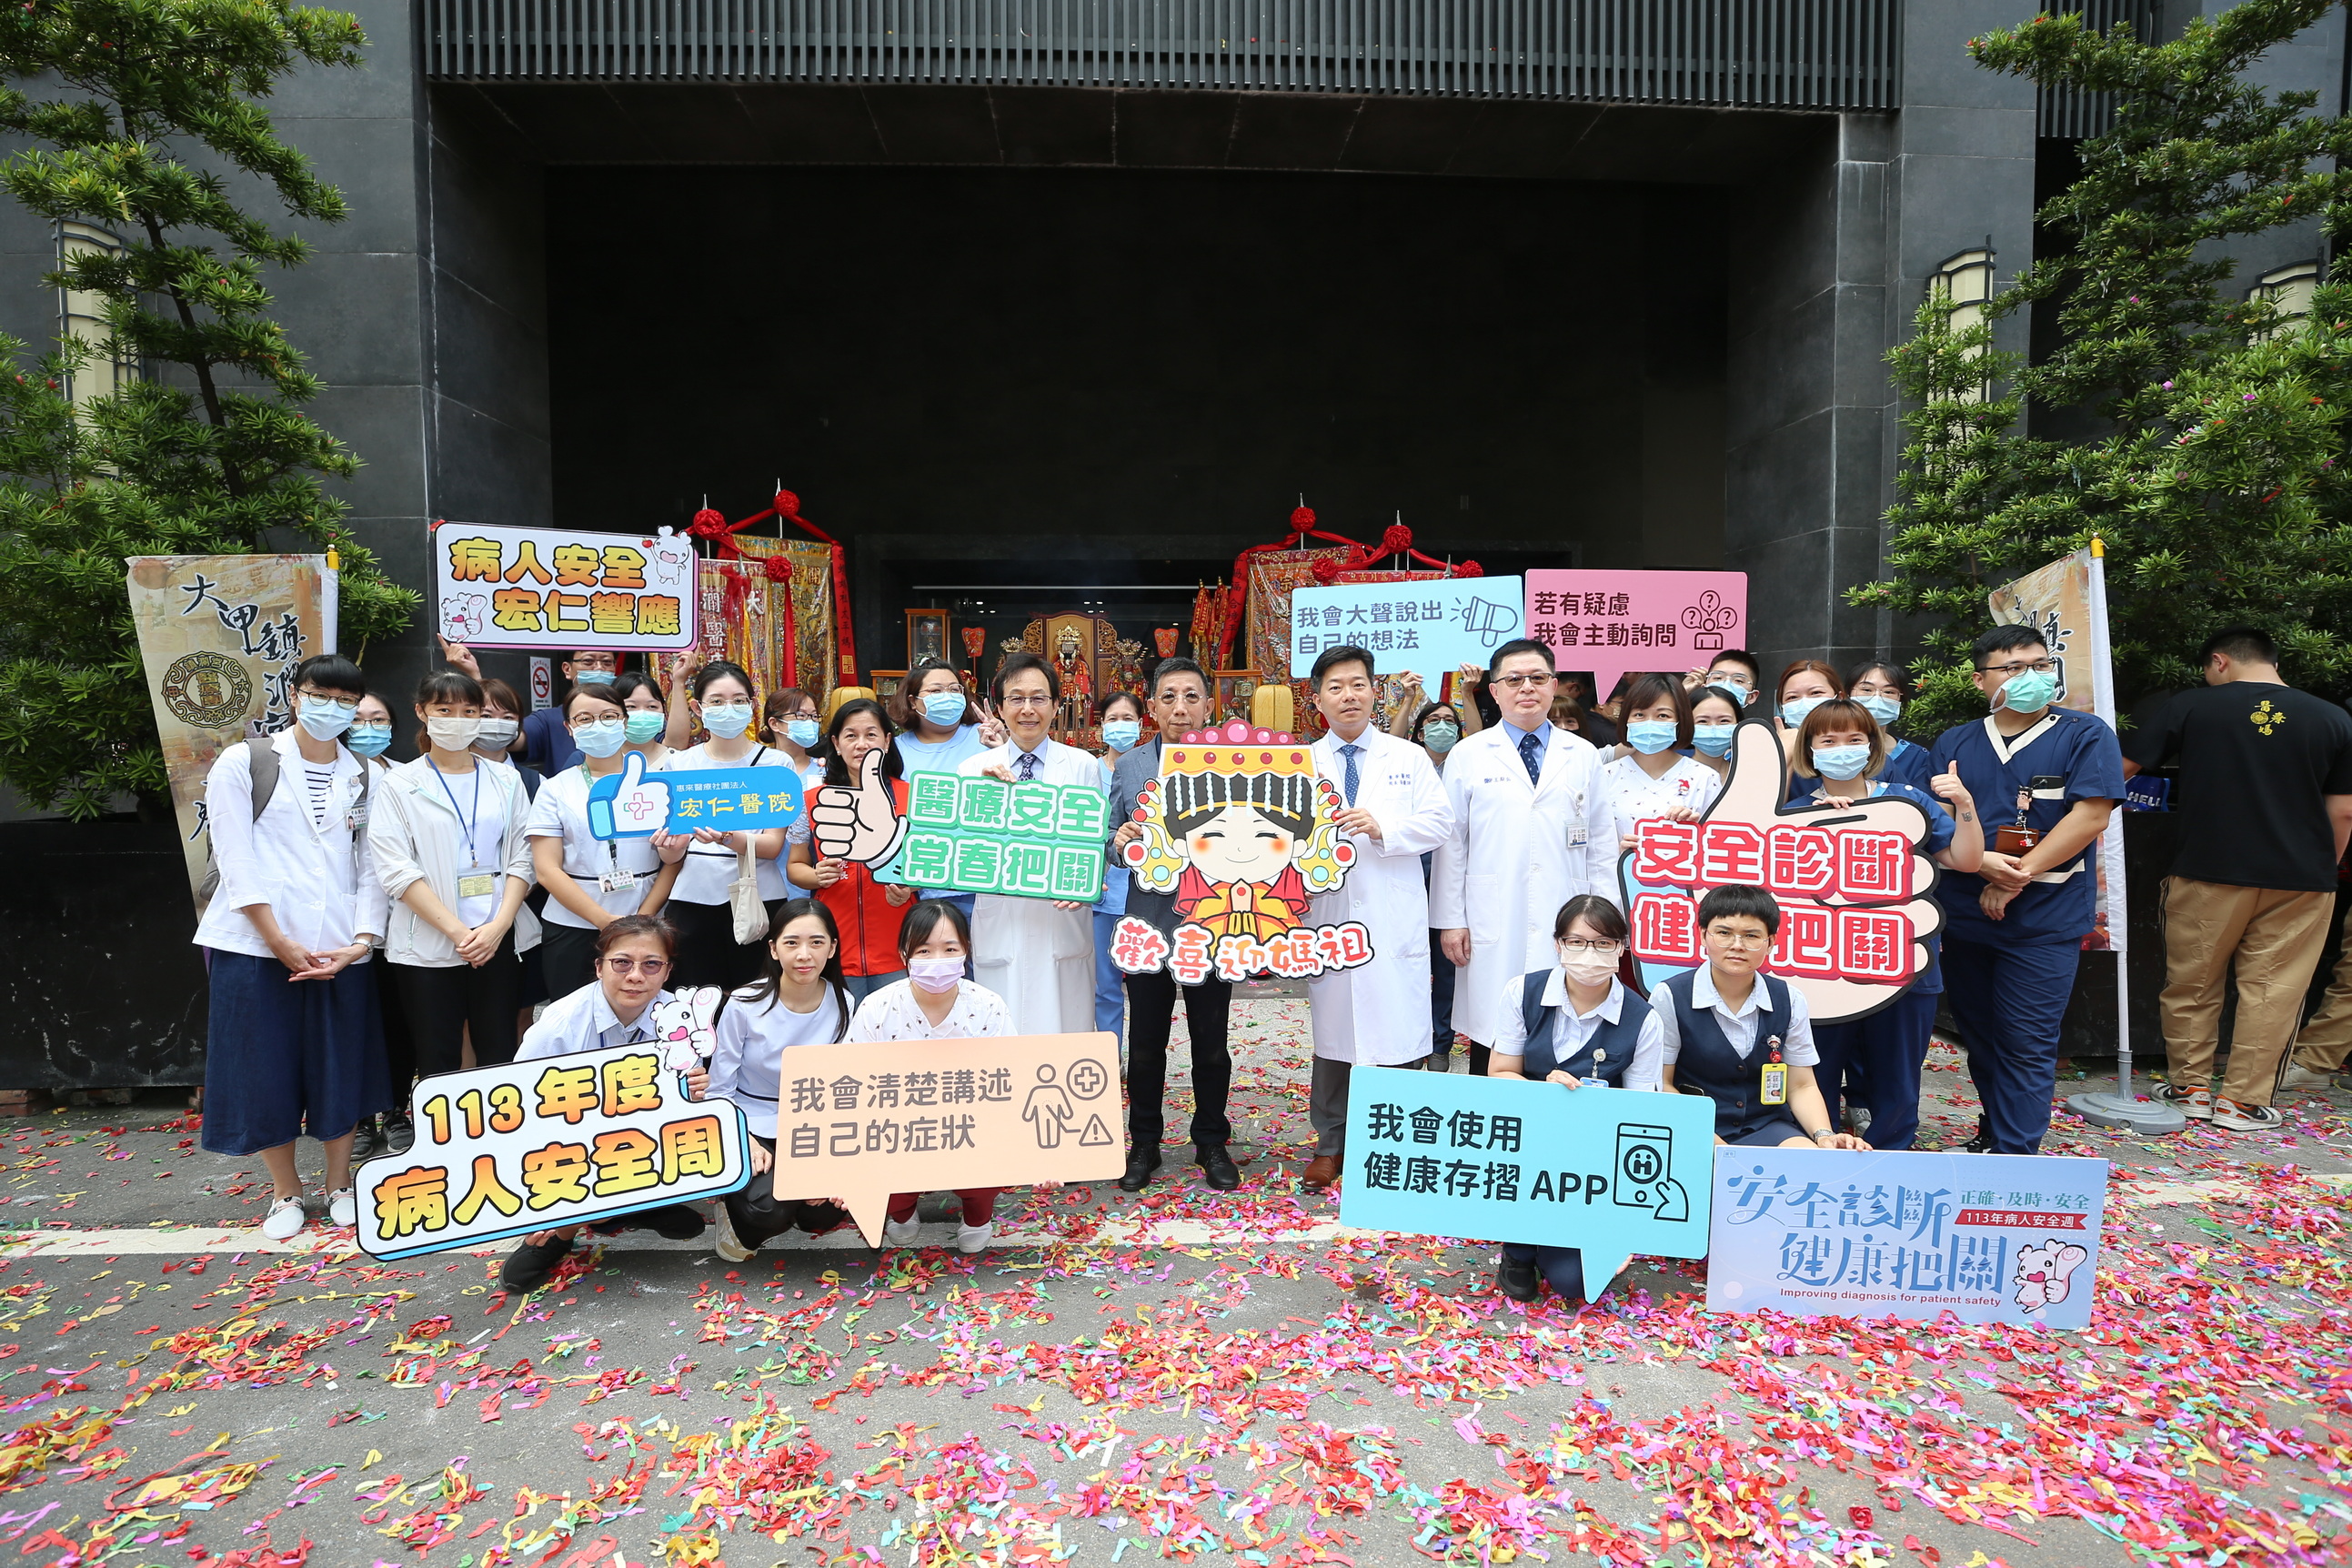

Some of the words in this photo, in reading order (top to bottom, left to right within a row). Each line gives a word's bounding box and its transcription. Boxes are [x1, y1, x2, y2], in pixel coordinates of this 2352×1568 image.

[449, 537, 647, 588] 病人安全
[492, 587, 680, 635] 宏仁響應
[1297, 599, 1443, 628] 我會大聲說出
[1534, 591, 1630, 616] 若有疑慮
[1533, 621, 1676, 647] 我會主動詢問
[676, 781, 748, 792] 惠來醫療社團法人
[677, 791, 796, 818] 宏仁醫院
[910, 773, 1106, 839] 醫療安全
[904, 834, 1101, 897] 常春把關
[1635, 819, 1905, 896] 安全診斷
[1114, 920, 1370, 980] 歡喜迎媽祖
[1633, 898, 1905, 979] 健把關
[789, 1067, 1013, 1114] 我會清楚講述
[789, 1114, 976, 1159] 自己的症狀
[1367, 1102, 1523, 1153] 我會使用
[372, 1115, 725, 1240] 病人安全周
[1363, 1151, 1521, 1203] 健康存摺
[1530, 1170, 1608, 1206] APP
[1726, 1164, 1953, 1248] 安全診斷
[1966, 1212, 2075, 1227] 113年病人安全週
[1776, 1232, 2007, 1294] 健康把關
[1780, 1288, 1837, 1300] Improving
[1841, 1290, 1896, 1302] diagnosis
[1900, 1293, 1916, 1302] for
[1920, 1293, 1962, 1304] patient
[1965, 1295, 2001, 1308] safety
